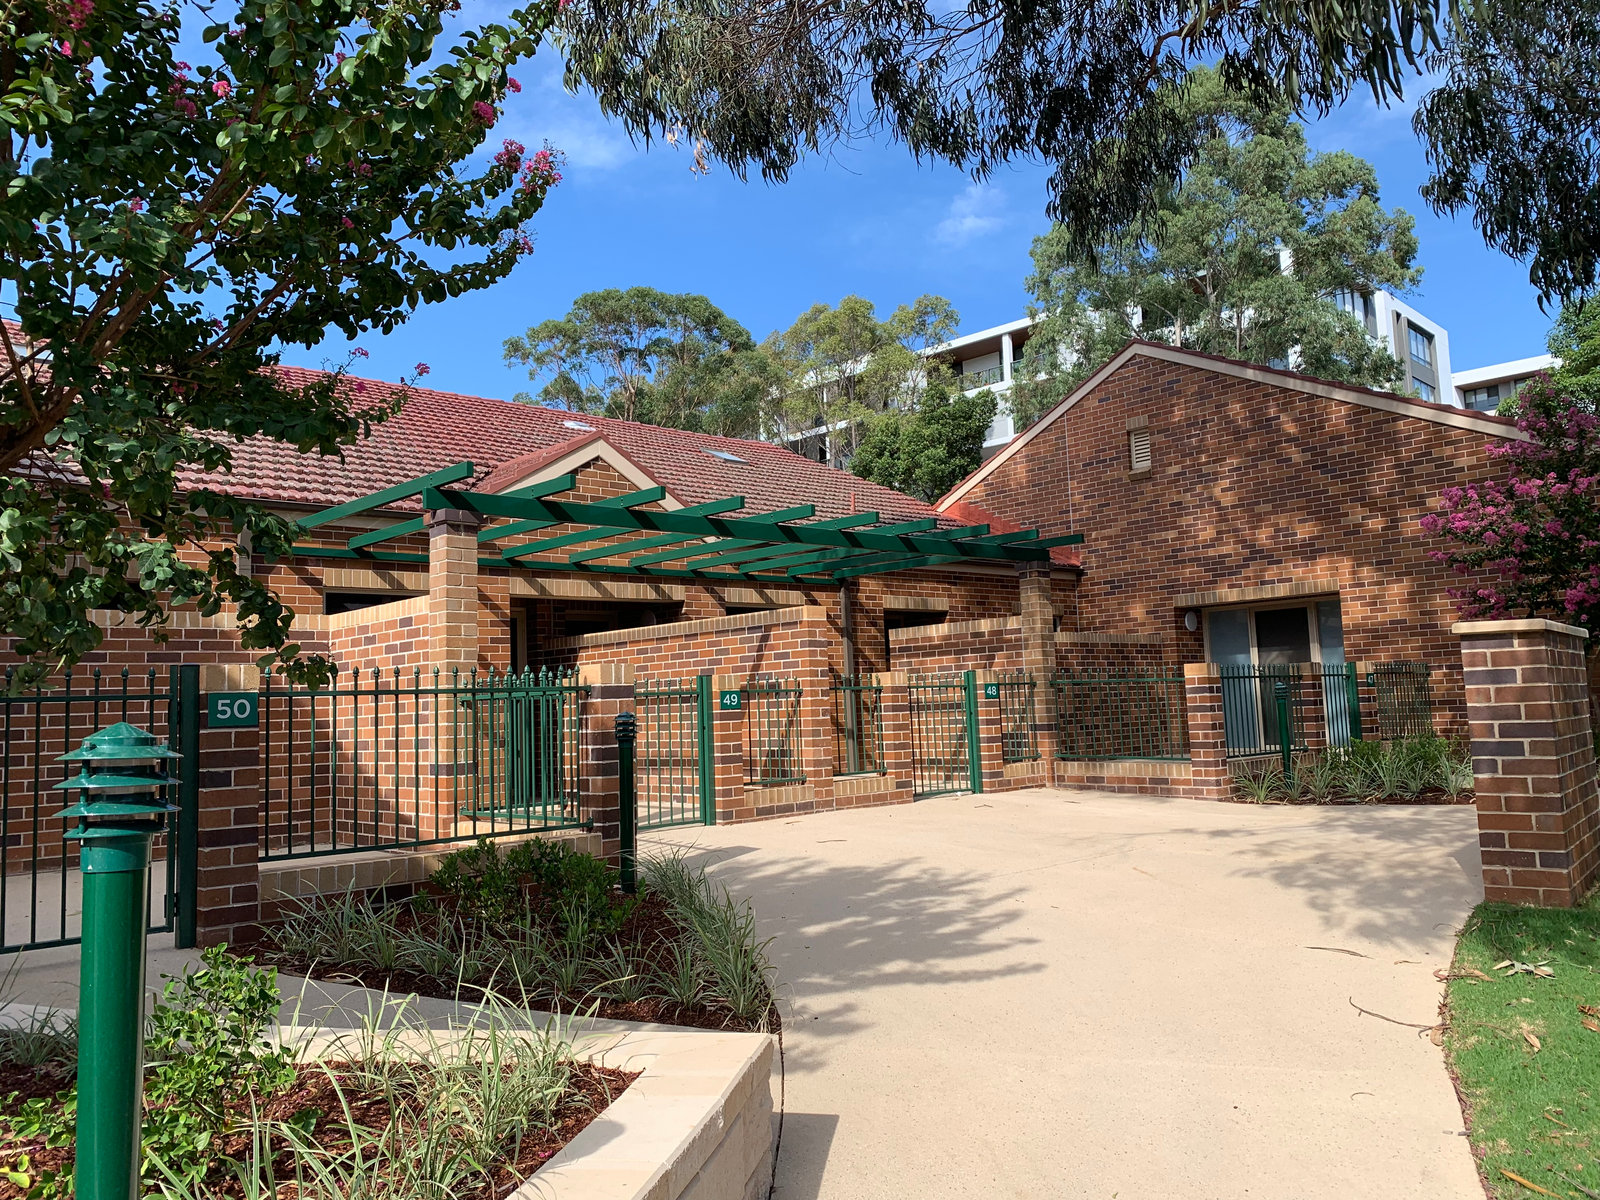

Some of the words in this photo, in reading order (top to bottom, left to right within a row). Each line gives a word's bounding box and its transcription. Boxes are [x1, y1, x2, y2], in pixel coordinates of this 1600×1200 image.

[987, 686, 997, 695] 48
[723, 694, 738, 705] 49
[216, 699, 250, 719] 50
